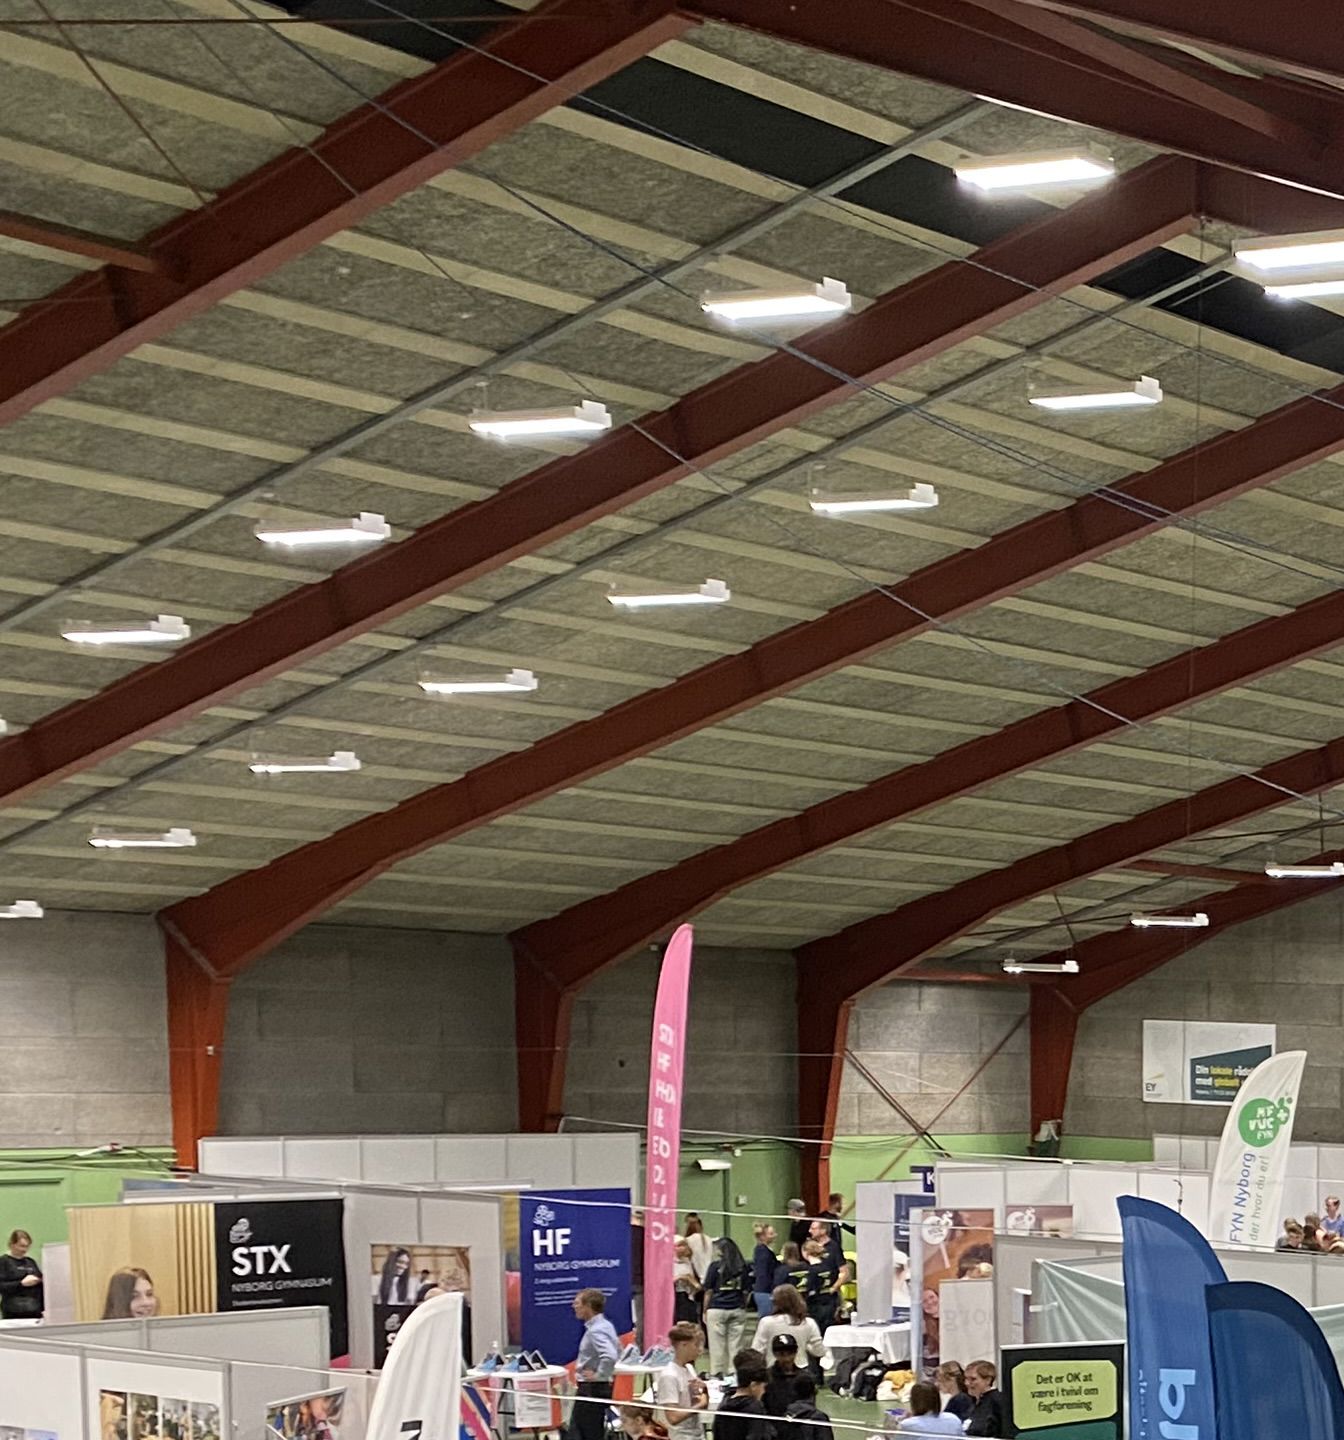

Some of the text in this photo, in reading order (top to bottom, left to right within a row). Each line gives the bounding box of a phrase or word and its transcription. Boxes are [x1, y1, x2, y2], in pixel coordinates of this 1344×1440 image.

[1145, 1081, 1157, 1092] EY
[1249, 1118, 1275, 1131] VUC
[1230, 1153, 1257, 1243] FYN Nyborg
[532, 1228, 571, 1257] HF
[232, 1244, 292, 1276] STX
[1036, 1372, 1093, 1384] Det er OK at
